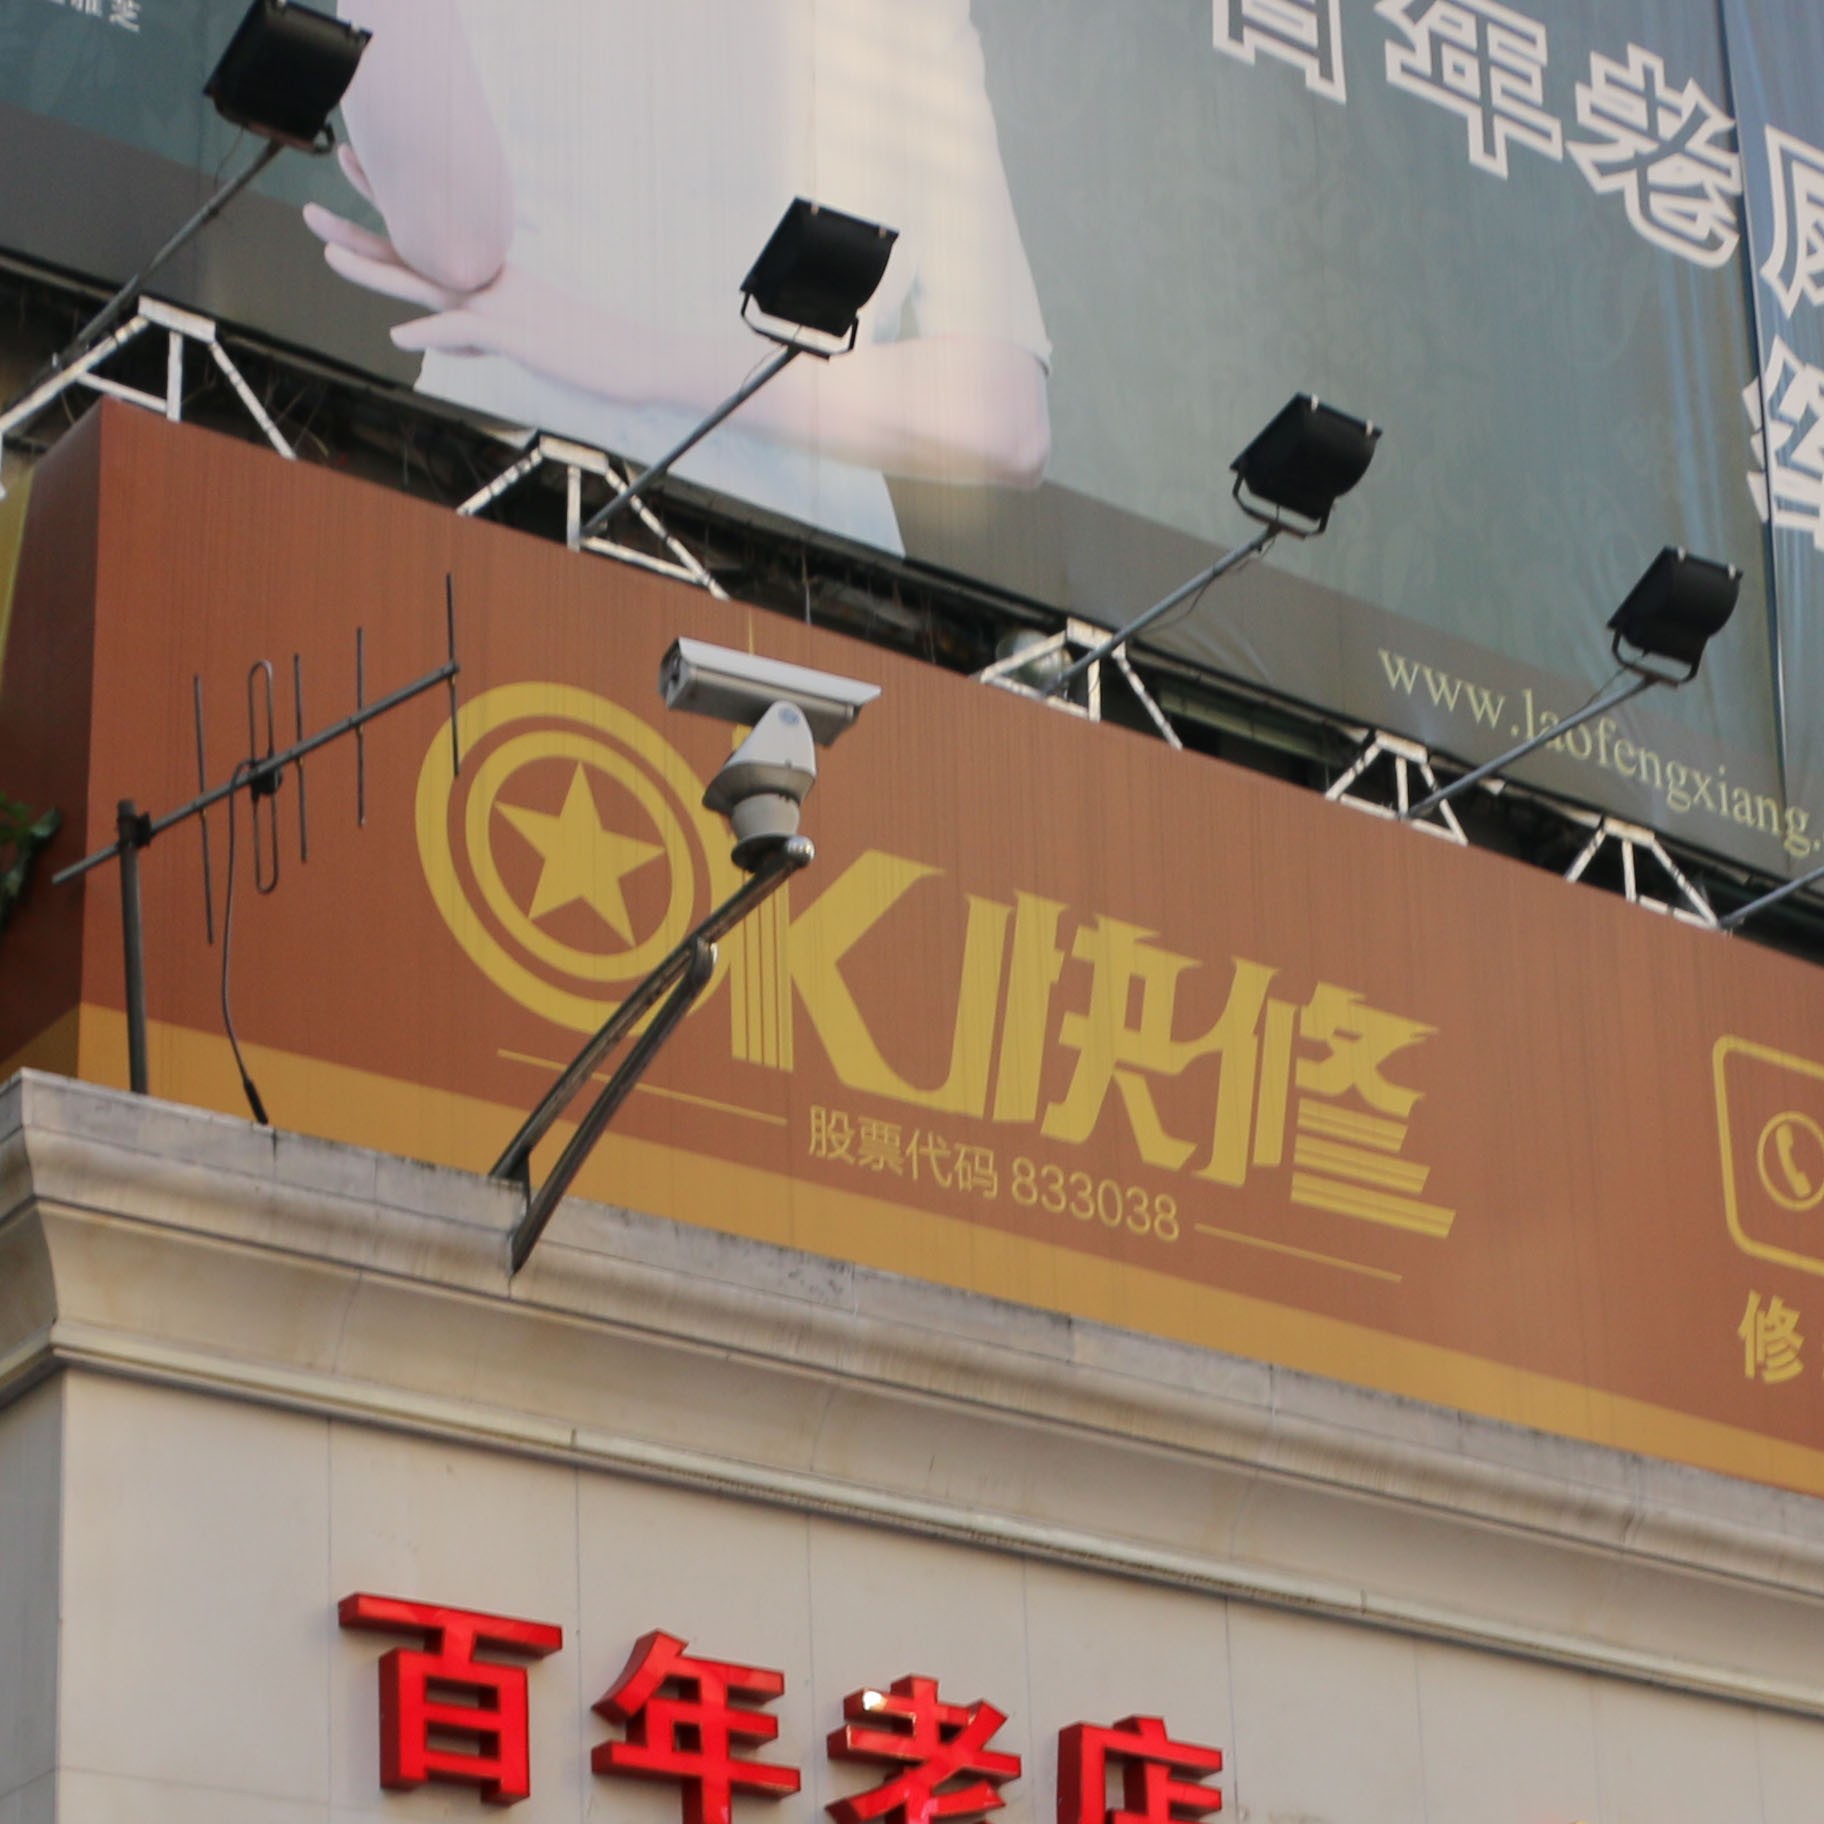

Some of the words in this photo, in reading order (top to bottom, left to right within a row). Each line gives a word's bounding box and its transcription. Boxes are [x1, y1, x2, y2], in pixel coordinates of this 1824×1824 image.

[806, 1105, 999, 1200] 股票代码
[1010, 1154, 1181, 1243] 833038
[1738, 1289, 1806, 1386] 修
